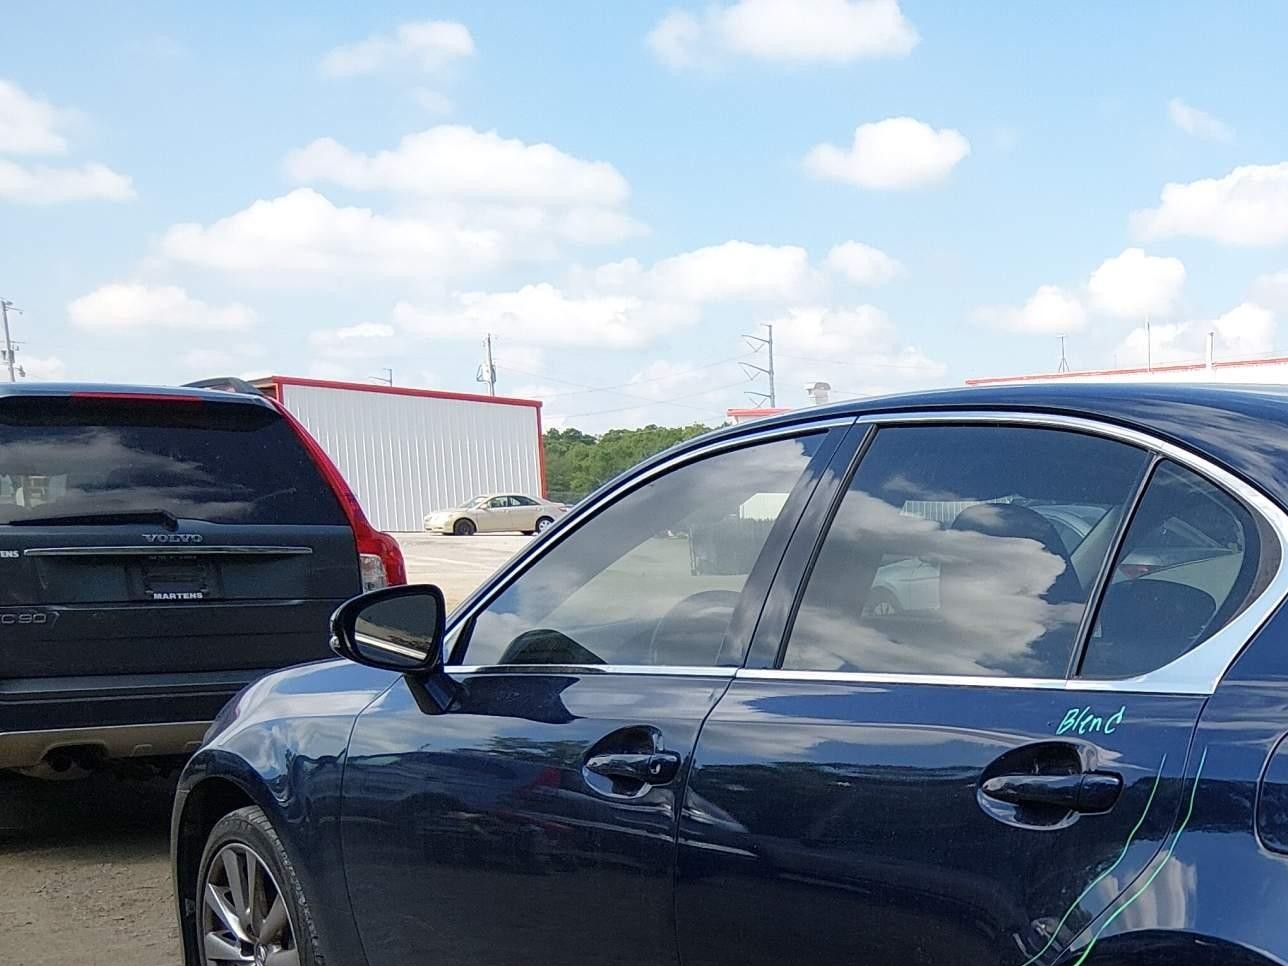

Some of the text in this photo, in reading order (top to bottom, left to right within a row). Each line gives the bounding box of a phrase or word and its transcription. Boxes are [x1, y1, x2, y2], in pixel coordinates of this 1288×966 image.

[142, 534, 203, 543] VOLVO
[0, 550, 20, 558] ENS
[153, 592, 203, 600] MARTENS
[0, 613, 47, 624] C90
